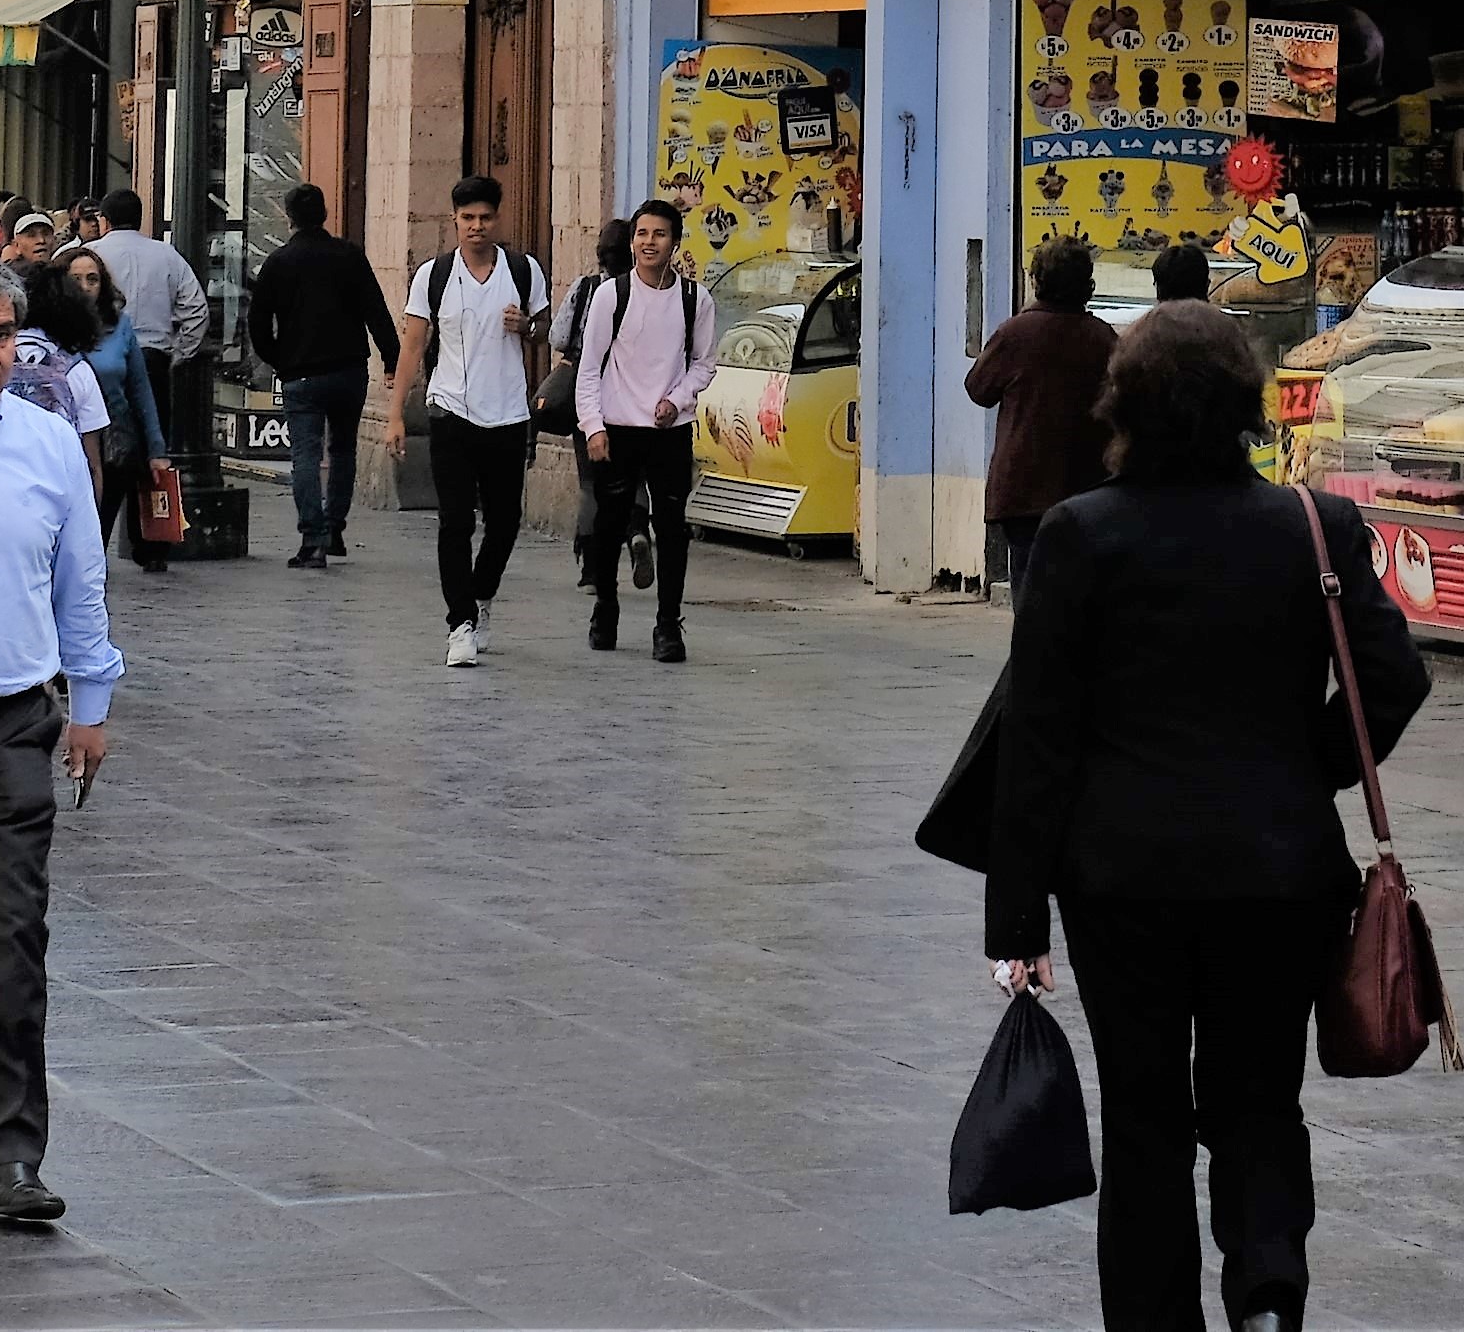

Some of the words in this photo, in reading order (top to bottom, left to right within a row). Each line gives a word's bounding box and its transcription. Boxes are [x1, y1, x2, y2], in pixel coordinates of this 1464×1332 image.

[255, 31, 296, 43] adidas
[1253, 23, 1334, 42] SANDWICH
[793, 122, 827, 139] VISA
[1031, 139, 1113, 157] PARA
[1120, 138, 1144, 149] LA
[1151, 137, 1232, 156] MESA
